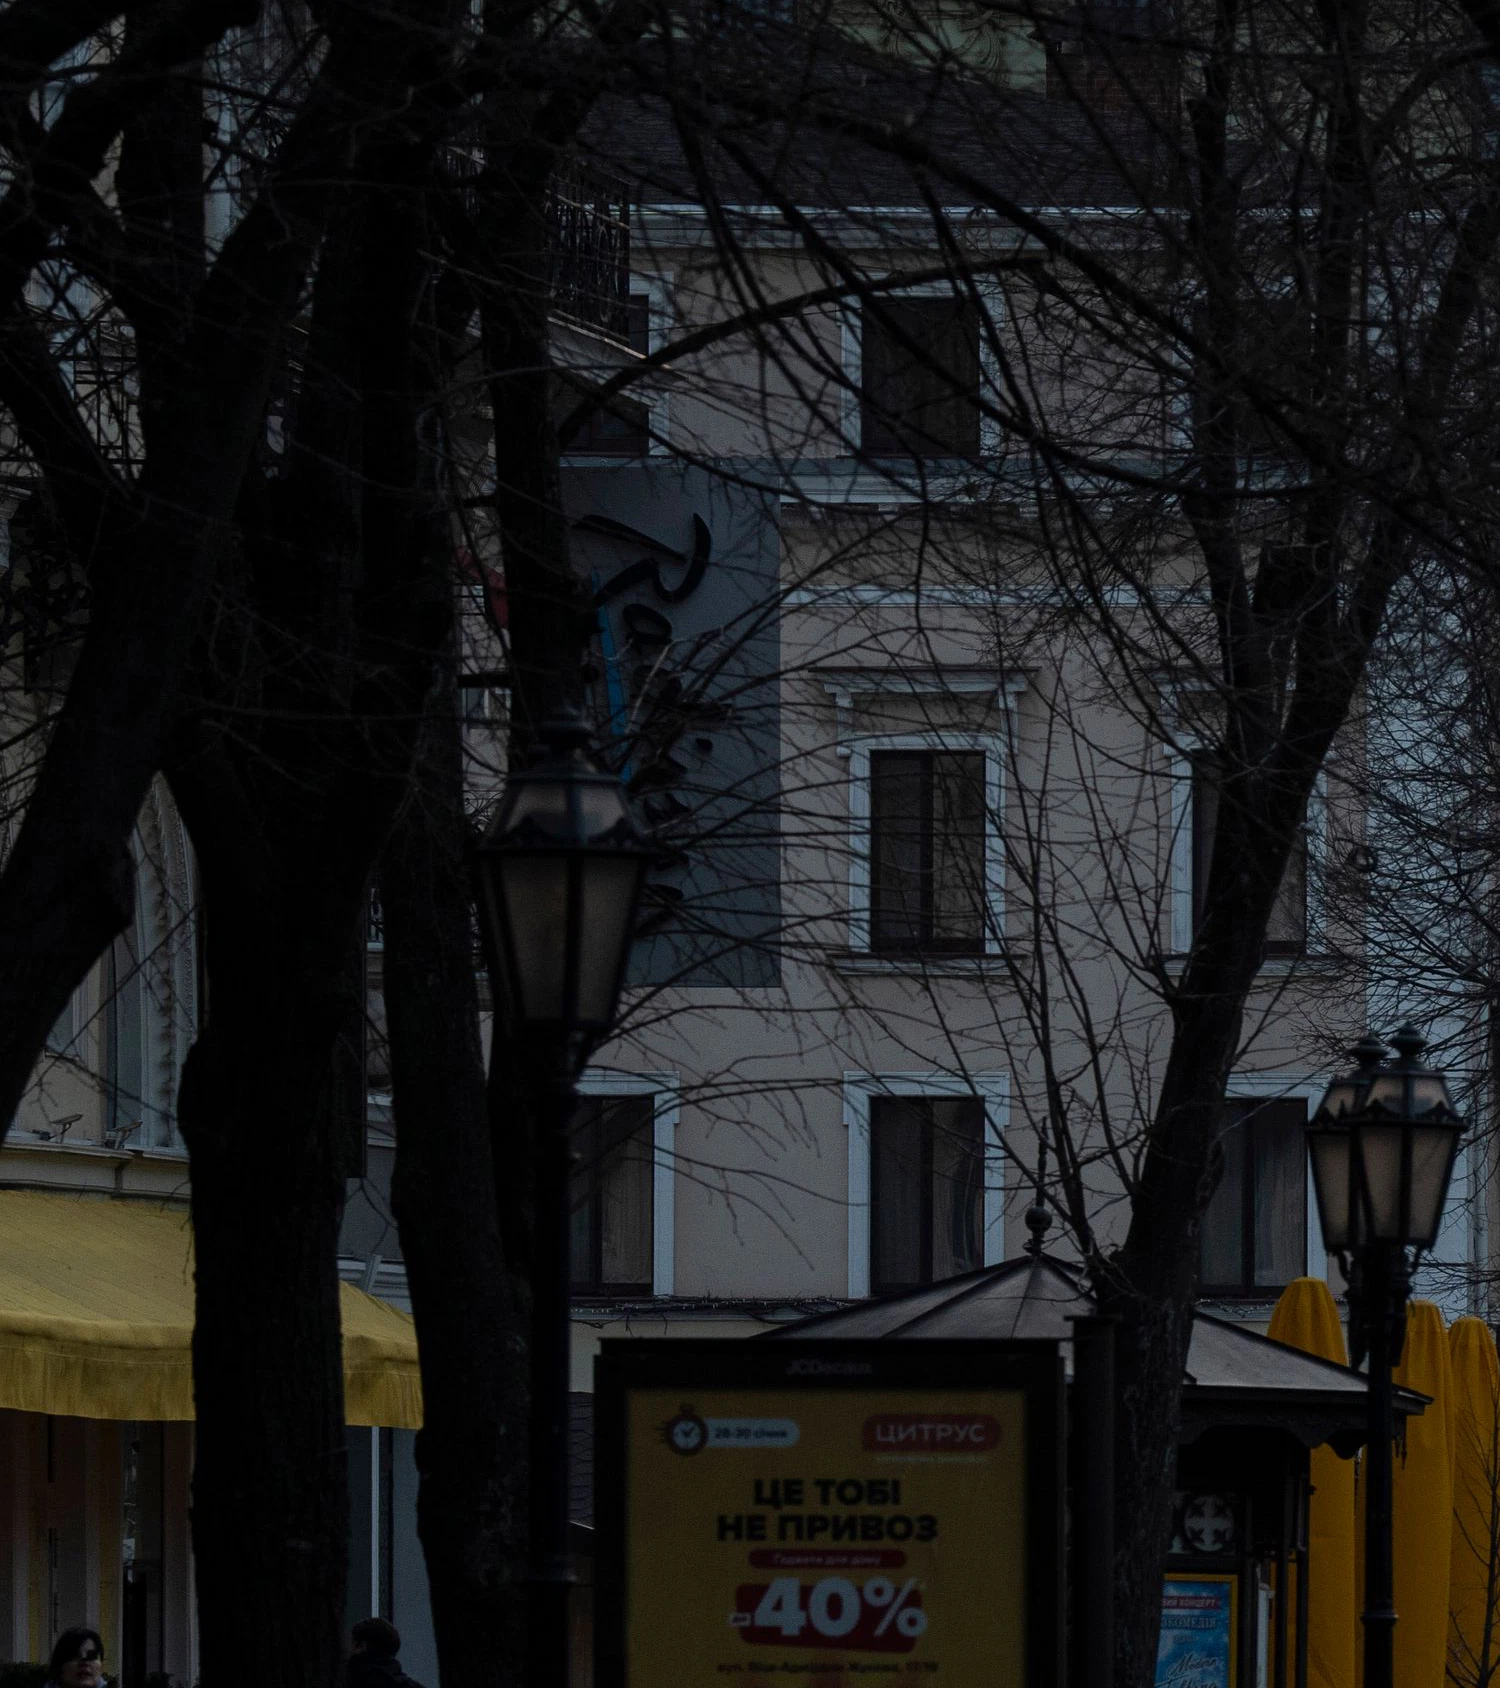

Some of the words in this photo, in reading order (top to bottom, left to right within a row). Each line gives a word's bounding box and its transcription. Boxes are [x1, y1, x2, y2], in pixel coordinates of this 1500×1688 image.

[875, 1422, 987, 1445] ЦИТРУС
[754, 1479, 804, 1509] ЦЕ
[815, 1479, 901, 1505] ТОБІ
[716, 1514, 768, 1541] НЕ
[779, 1514, 939, 1541] ПРИВОЗ
[753, 1575, 929, 1638] 40%
